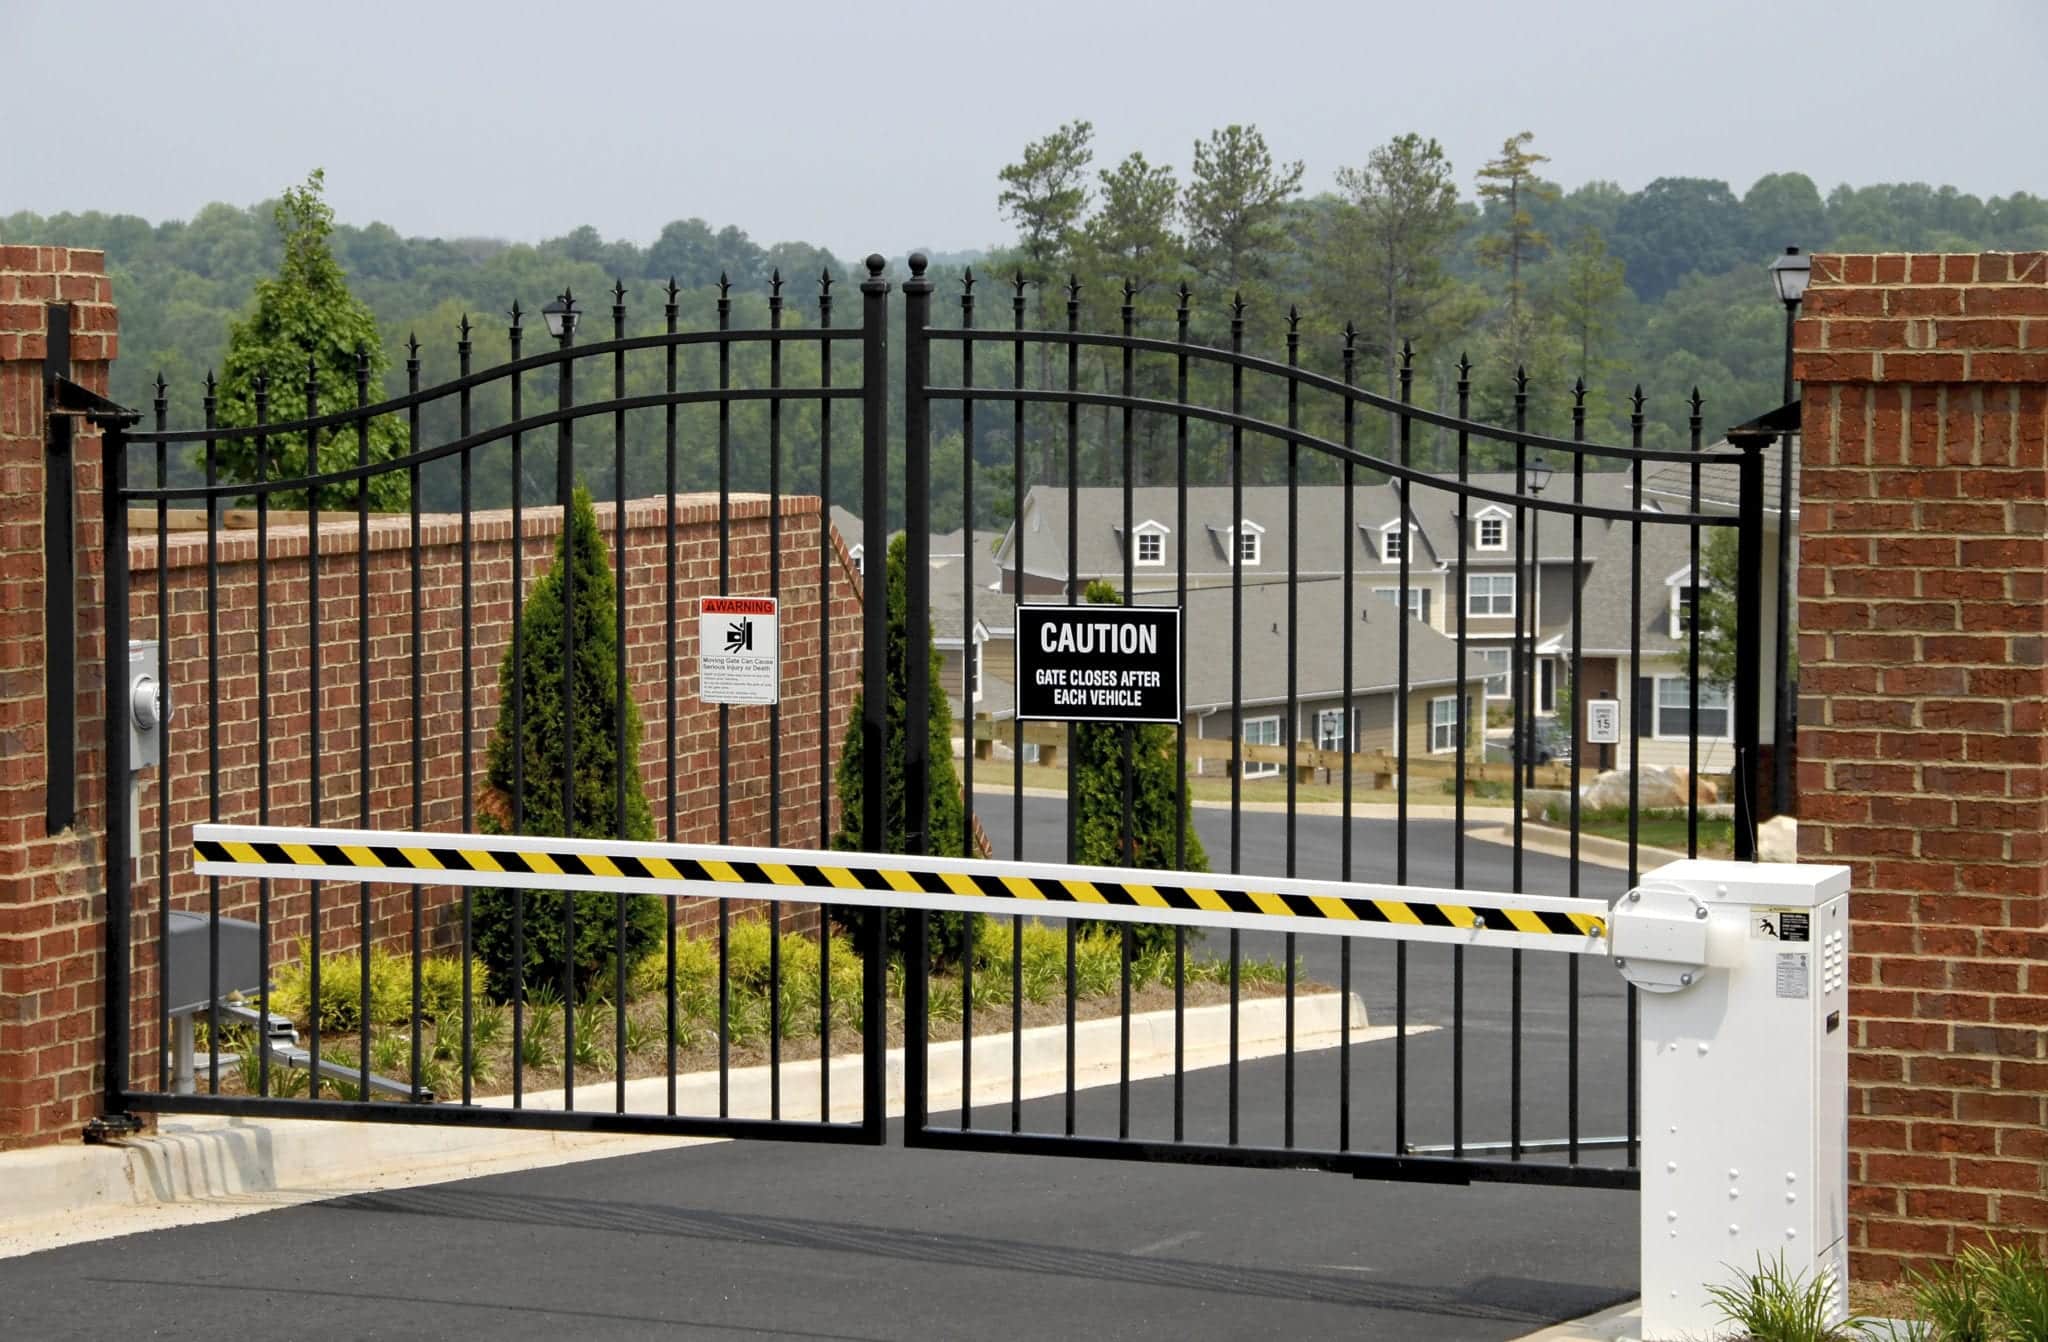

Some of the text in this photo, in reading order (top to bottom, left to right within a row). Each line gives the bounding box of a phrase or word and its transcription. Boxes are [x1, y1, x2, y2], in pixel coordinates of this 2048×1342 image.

[716, 601, 773, 613] WARNING
[1040, 622, 1157, 654] CAUTION
[703, 657, 725, 665] Moving
[1035, 669, 1161, 687] GATE CLOSES AFTER
[1054, 689, 1142, 706] EACH VEHICLE
[1597, 719, 1610, 729] 15
